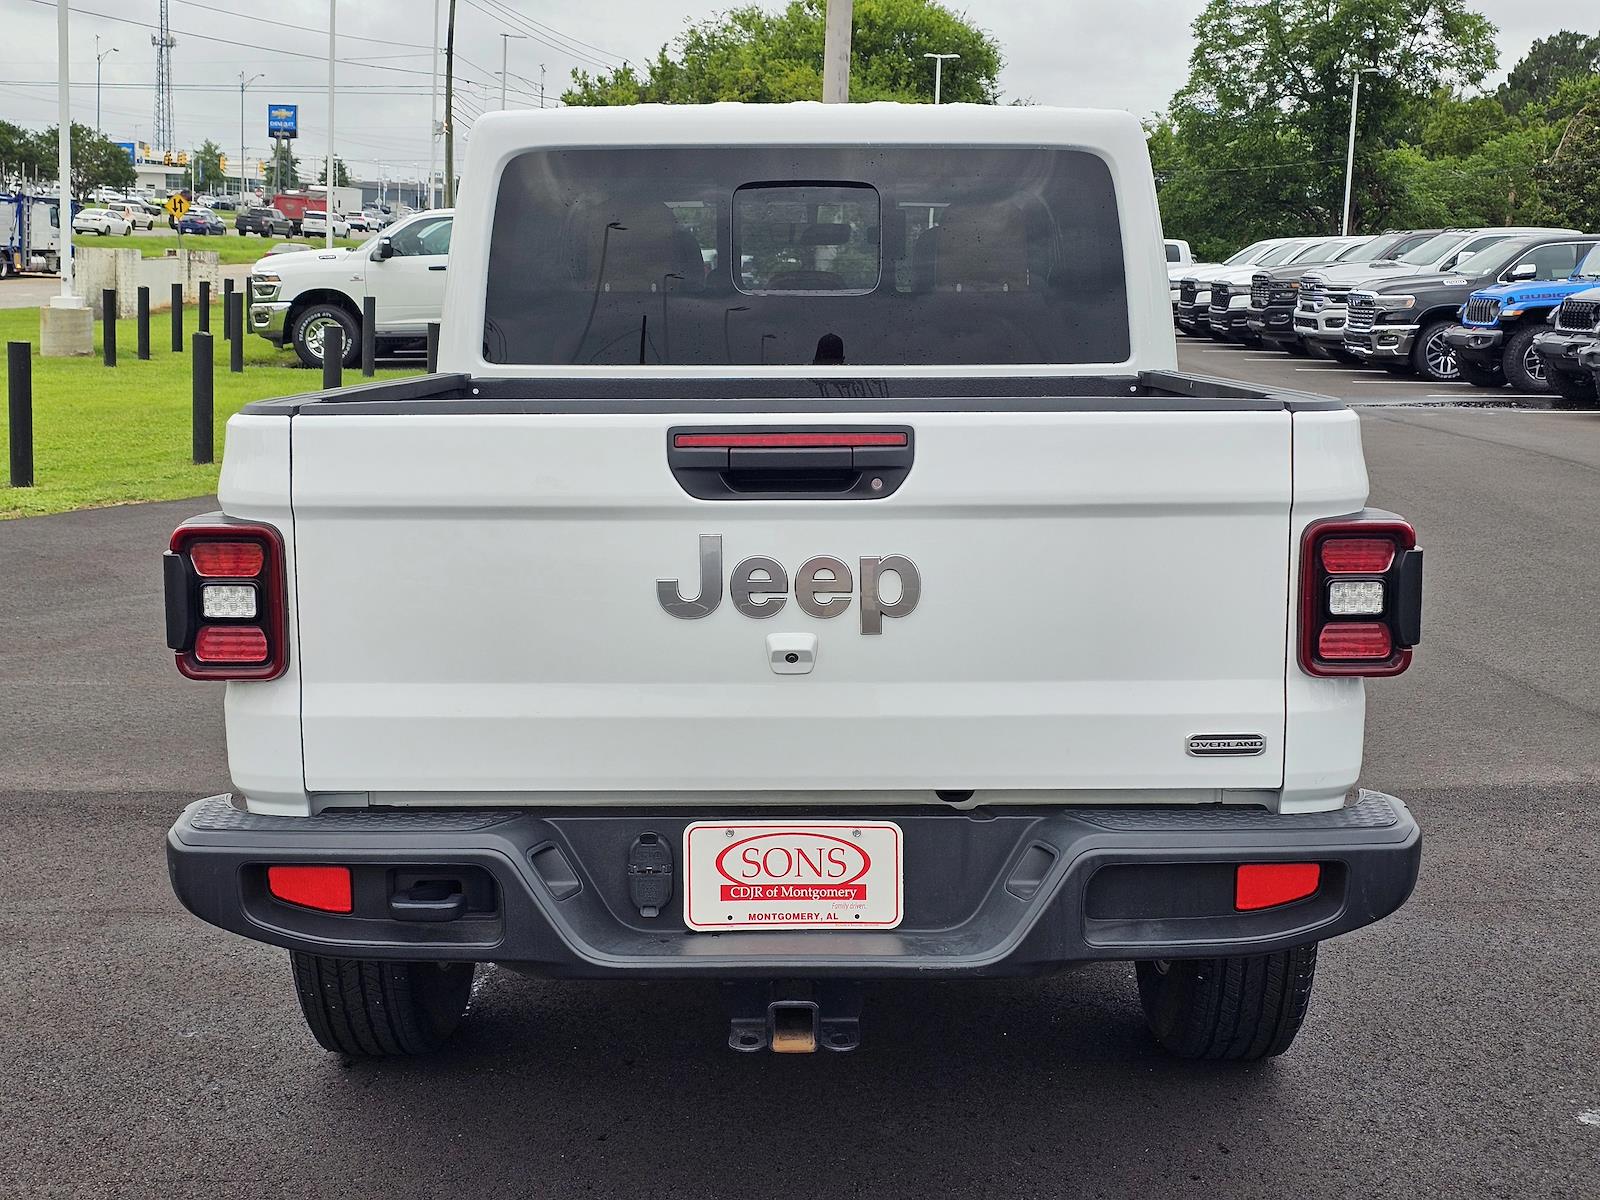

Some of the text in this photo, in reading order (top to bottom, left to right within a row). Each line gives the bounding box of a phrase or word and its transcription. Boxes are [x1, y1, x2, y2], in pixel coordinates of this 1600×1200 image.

[1519, 291, 1576, 300] RUBICO
[656, 533, 922, 636] Jeep
[741, 847, 848, 878] SONS
[730, 886, 857, 900] CDJR of Montgomery
[748, 912, 839, 921] MONTGOMERY, AL
